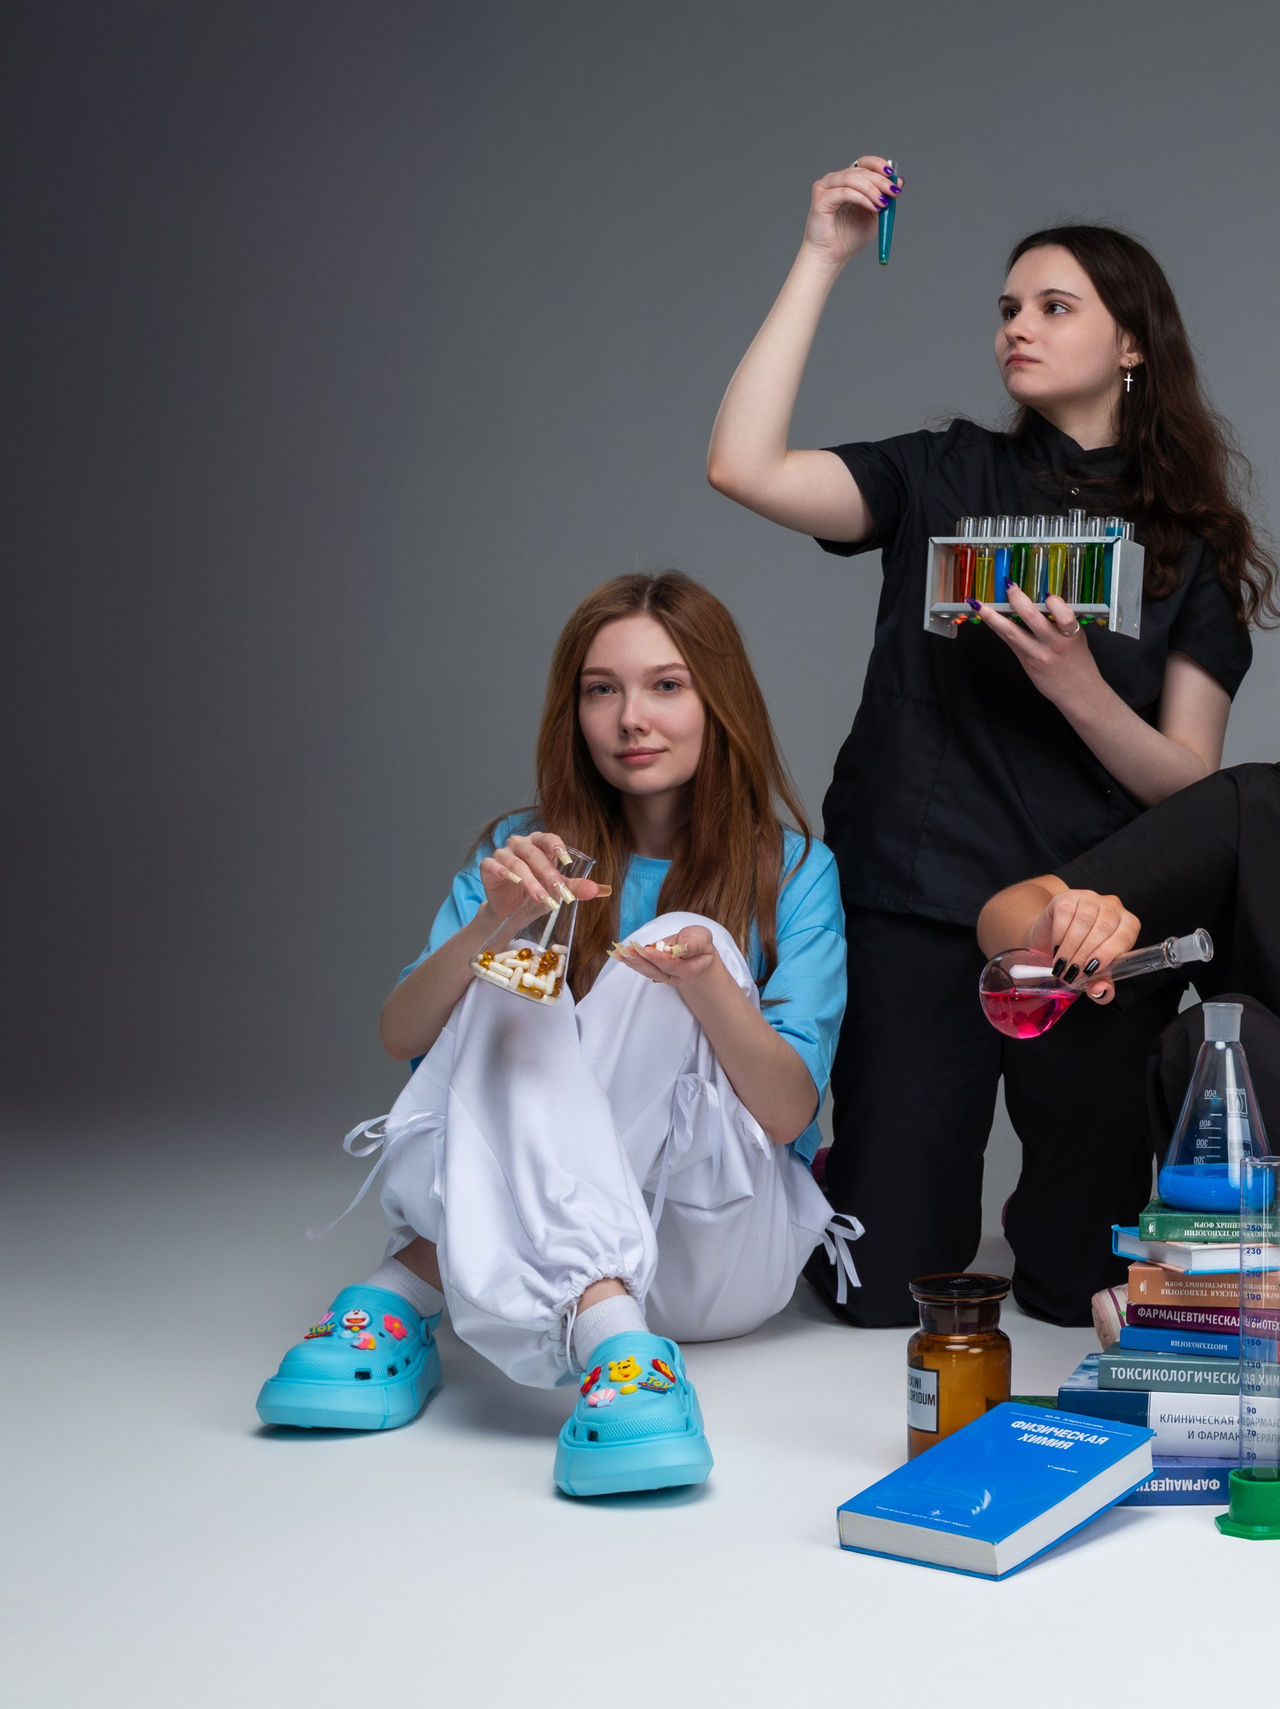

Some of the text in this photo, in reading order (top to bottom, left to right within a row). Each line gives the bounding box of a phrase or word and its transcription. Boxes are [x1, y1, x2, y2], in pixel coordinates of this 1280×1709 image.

[1193, 1221, 1215, 1229] ФОРМ
[1184, 1229, 1230, 1237] ТЕХНОЛОГИИ
[1246, 1247, 1261, 1255] 230
[1246, 1270, 1261, 1278] 210
[1185, 1281, 1240, 1289] ЛЕКАРСТВЕННЫХ
[1160, 1288, 1208, 1297] ТЕХНОЛОГИЯ
[1246, 1293, 1261, 1301] 190
[1171, 1340, 1228, 1351] БИОТЕХНОЛОГИЯ
[1246, 1339, 1261, 1347] 150
[1245, 1361, 1261, 1369] 130
[1245, 1384, 1261, 1392] 110
[1246, 1406, 1257, 1415] 90
[1159, 1413, 1234, 1426] КЛИНИЧЕСКАЯ
[1010, 1420, 1110, 1445] ФИЗИЧЕСКАЯ
[1187, 1430, 1195, 1440] И
[1246, 1430, 1257, 1438] 70
[1017, 1432, 1075, 1450] ХИМИЯ
[1246, 1452, 1257, 1460] 50
